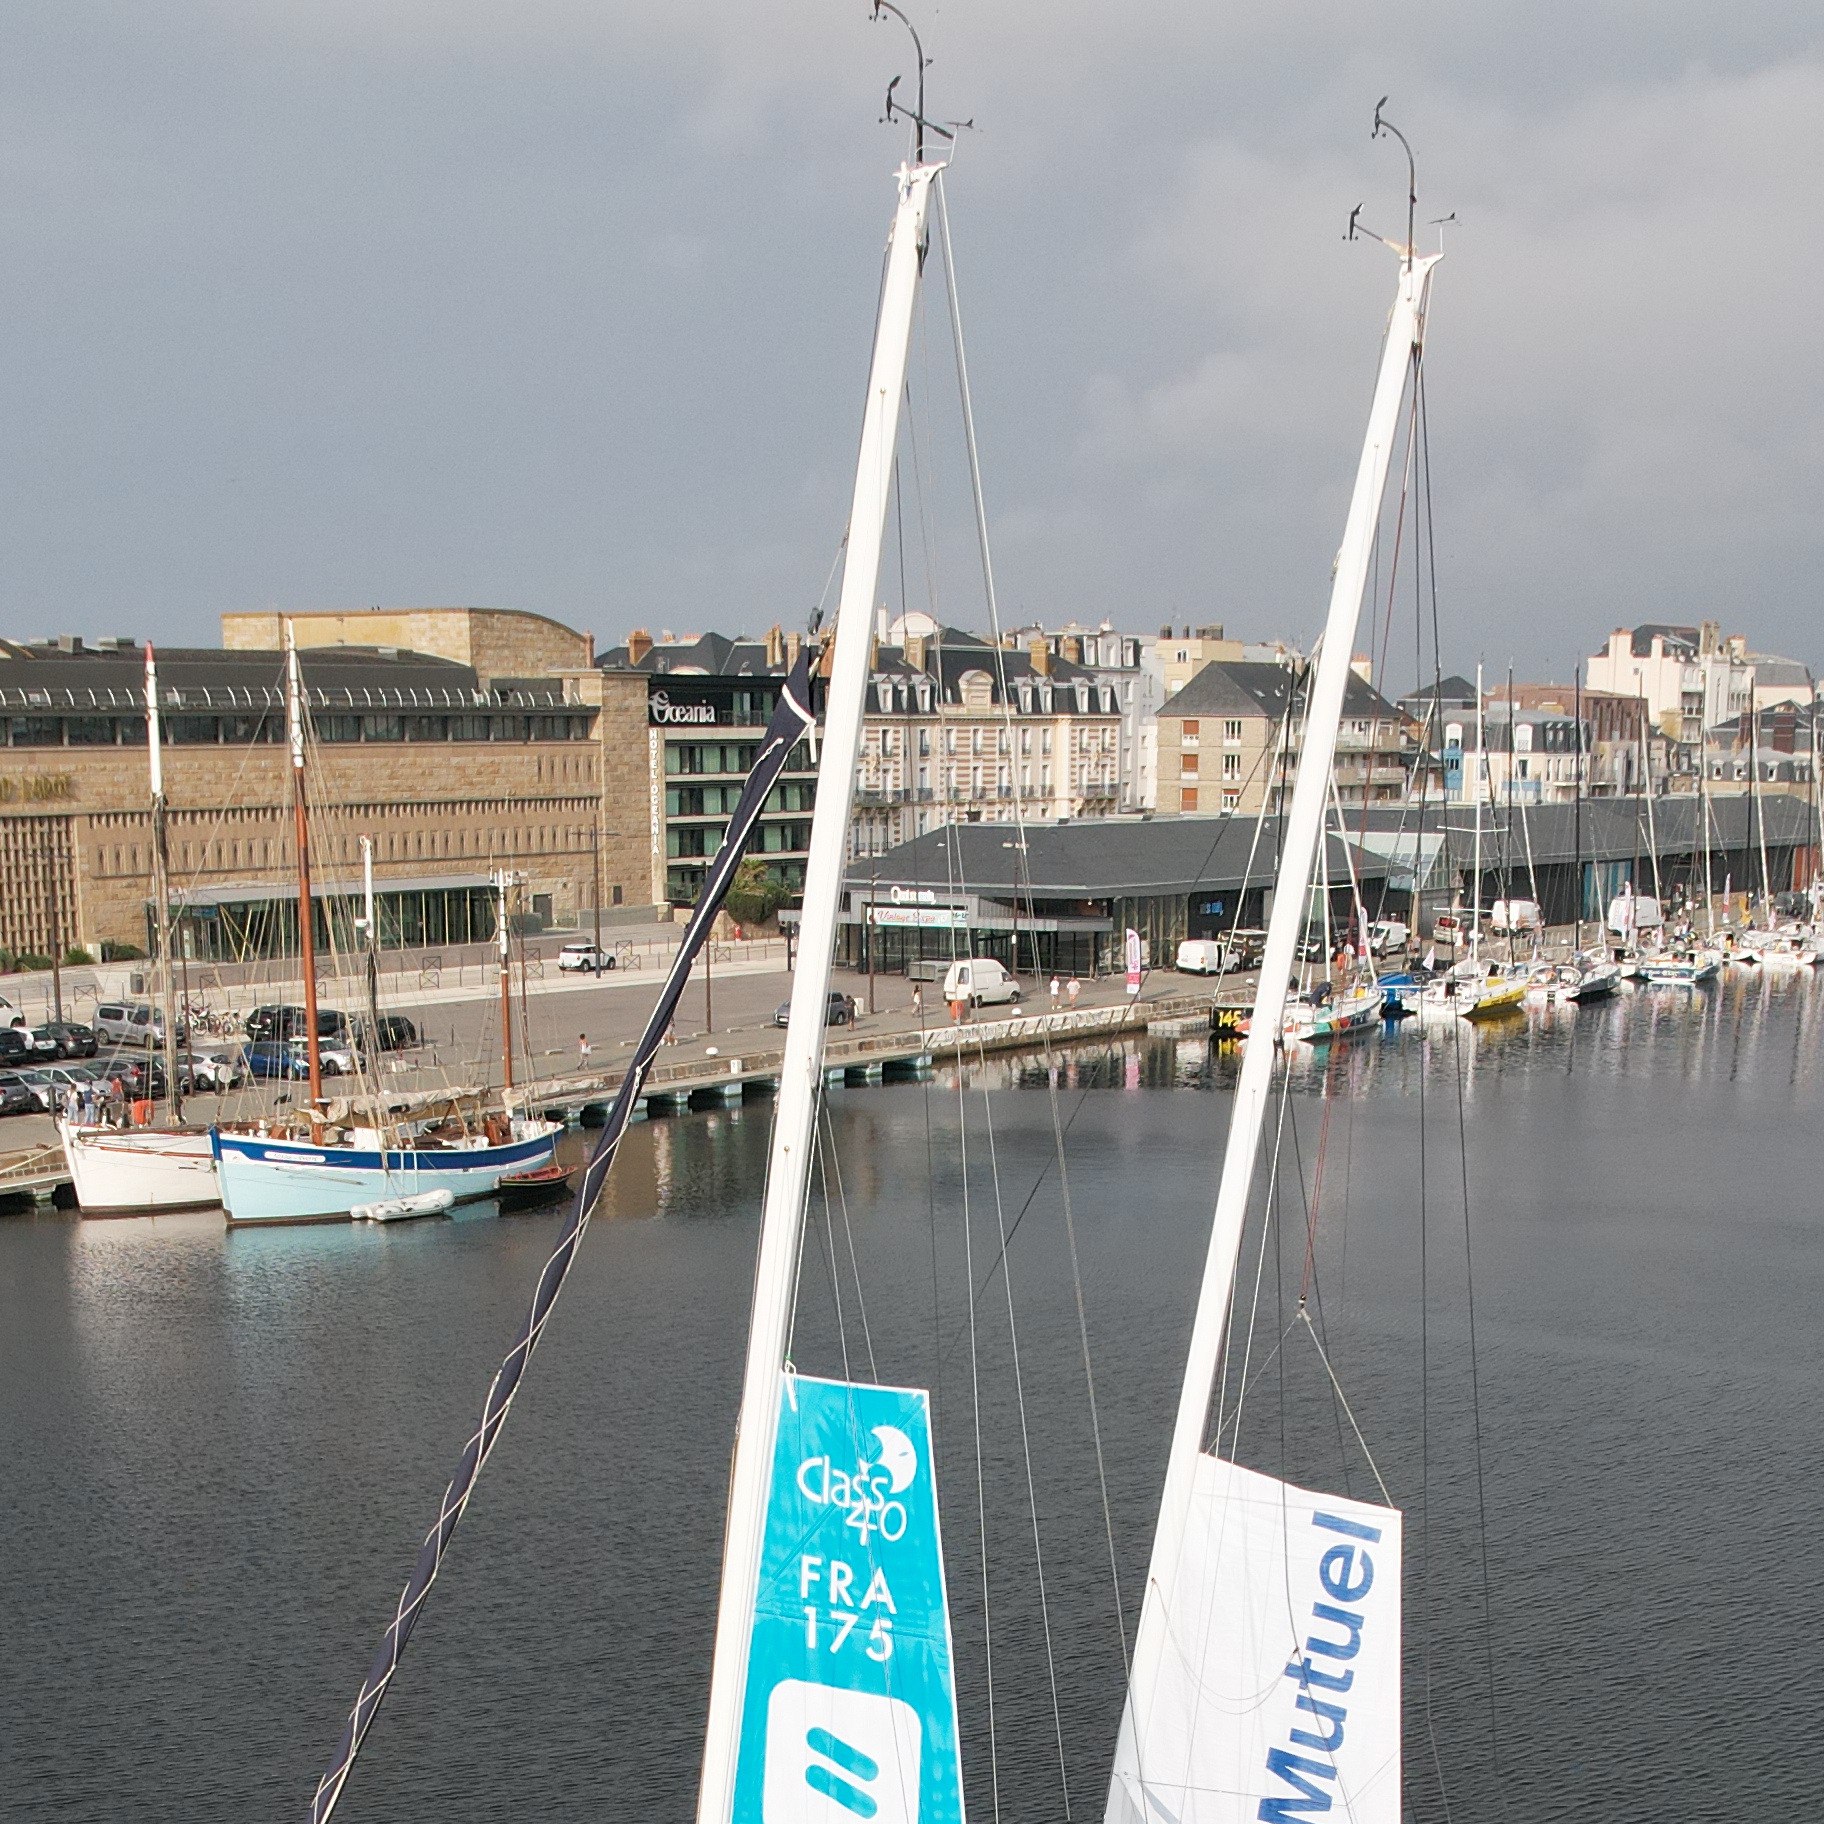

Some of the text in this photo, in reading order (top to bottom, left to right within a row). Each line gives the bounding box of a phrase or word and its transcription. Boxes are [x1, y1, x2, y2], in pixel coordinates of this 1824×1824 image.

[649, 690, 716, 723] Oceania
[649, 729, 660, 854] HOTEL OCEANIA
[1219, 1010, 1243, 1027] 145
[796, 1455, 889, 1512] Class
[800, 1554, 897, 1615] FRA
[804, 1606, 894, 1662] 175
